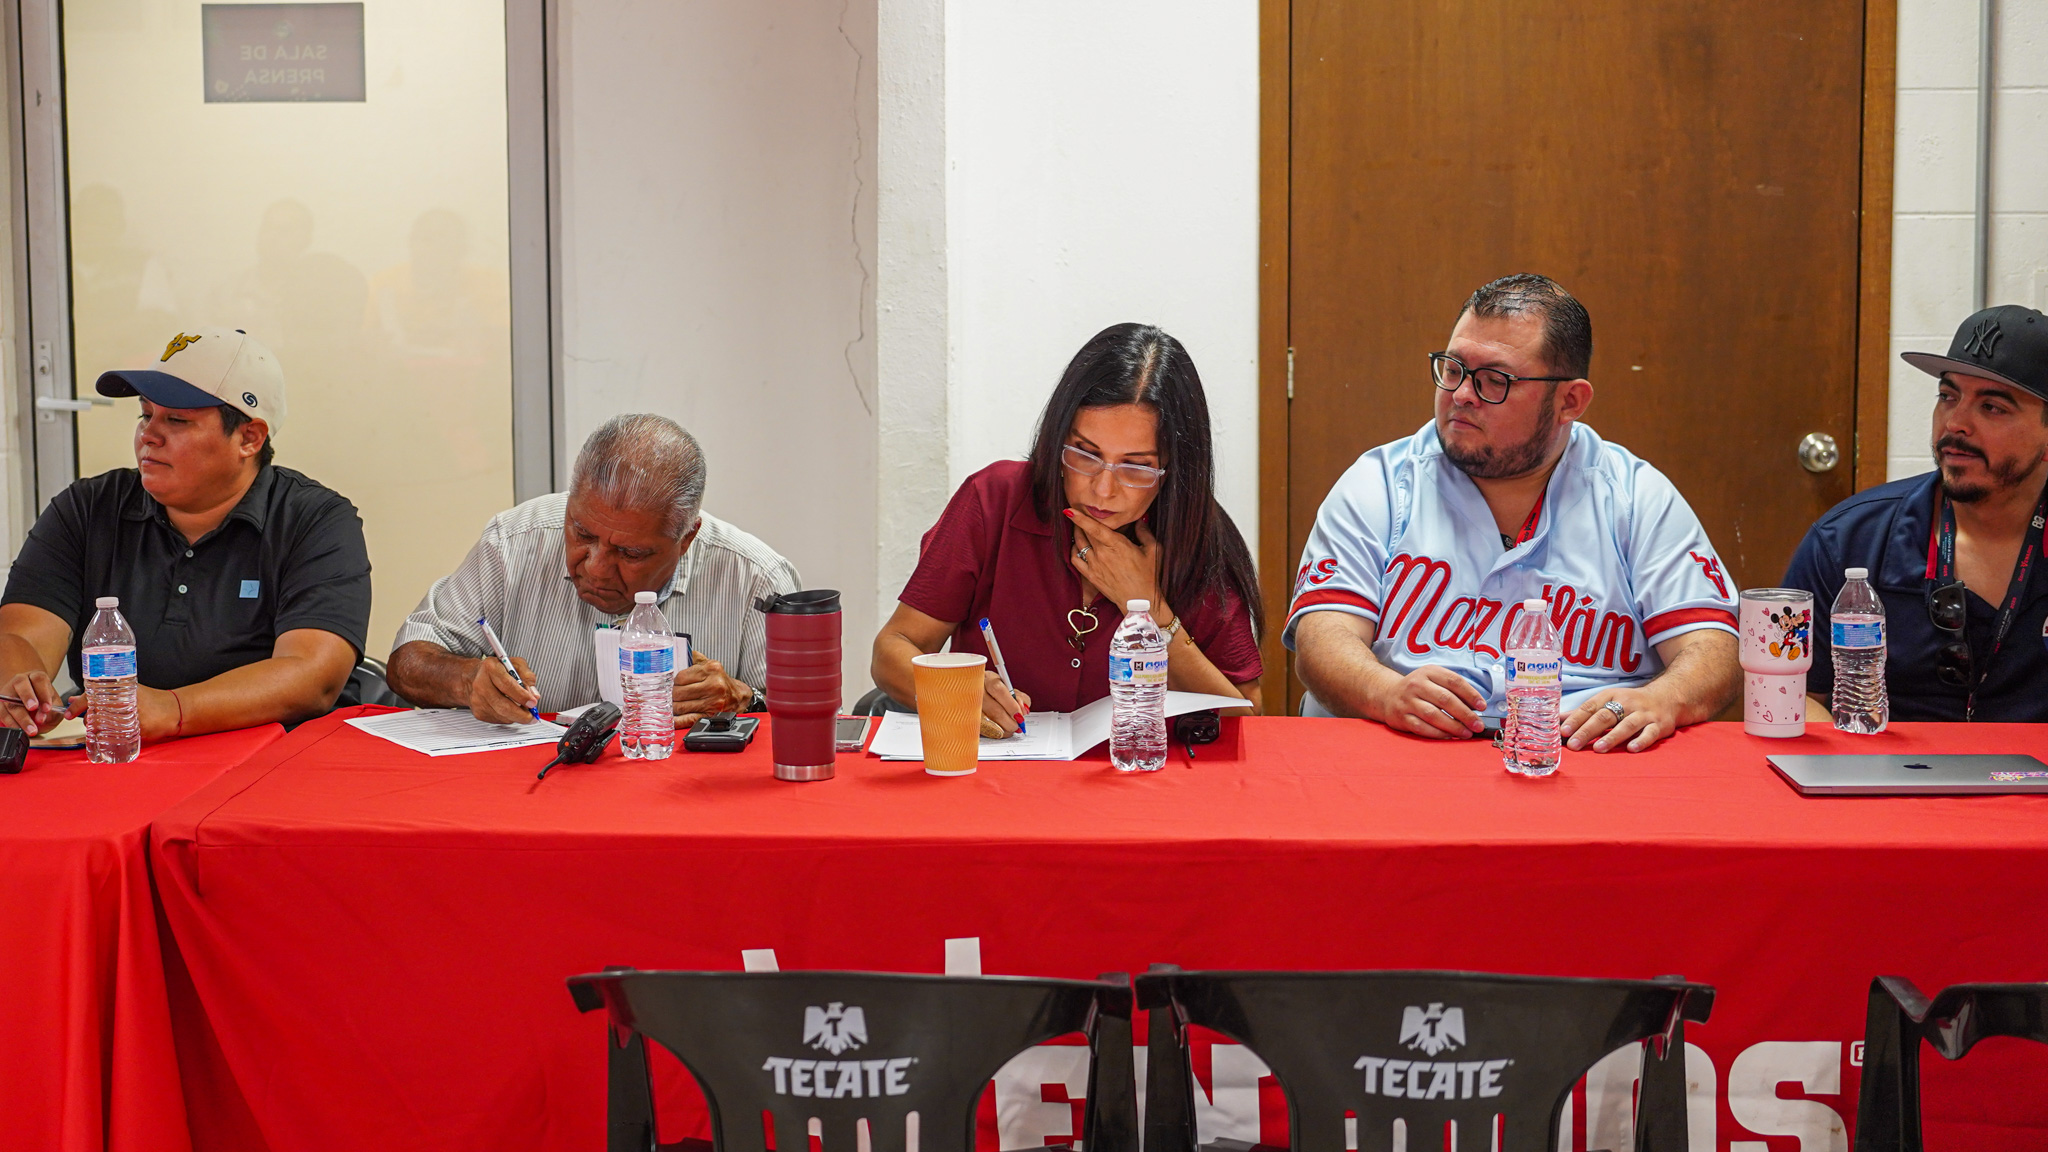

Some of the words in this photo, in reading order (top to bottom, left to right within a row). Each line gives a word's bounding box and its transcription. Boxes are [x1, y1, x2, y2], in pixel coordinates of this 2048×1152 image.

[1527, 661, 1558, 674] agua
[761, 1056, 913, 1099] TECATE
[1353, 1055, 1509, 1100] TECATE
